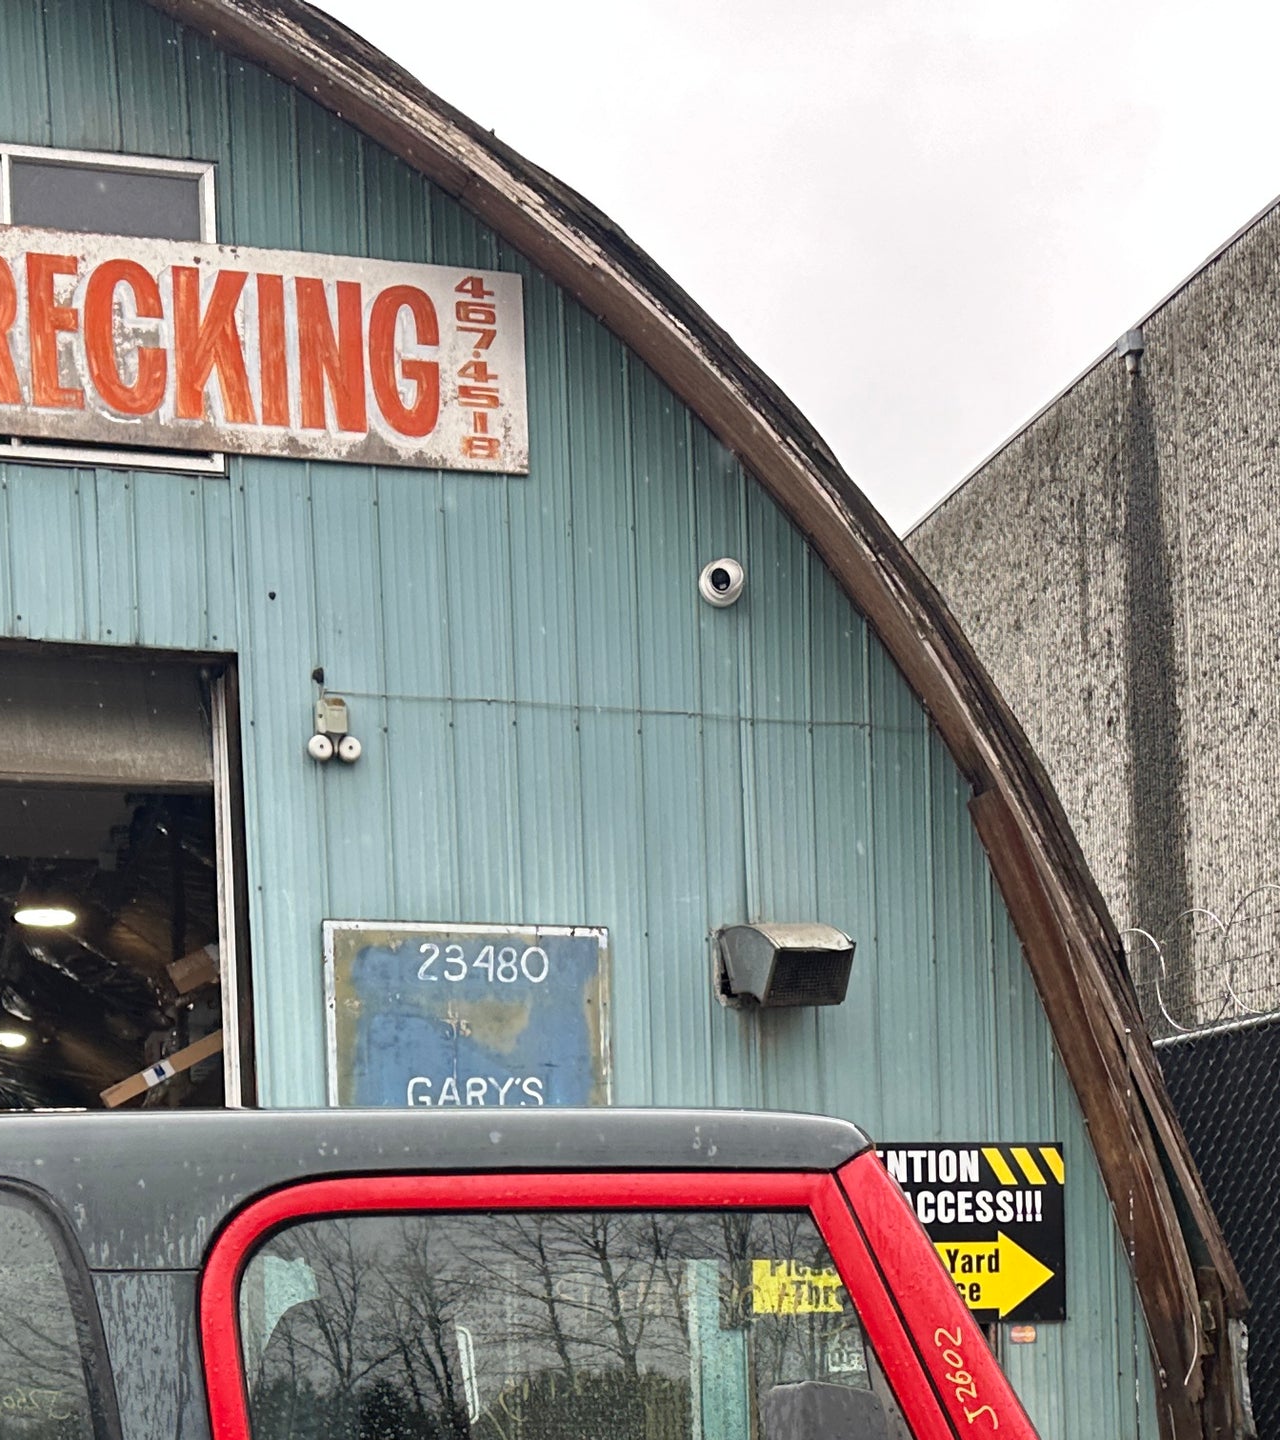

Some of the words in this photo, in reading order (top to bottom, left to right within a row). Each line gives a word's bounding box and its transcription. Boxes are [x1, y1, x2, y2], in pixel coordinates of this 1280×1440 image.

[417, 943, 549, 983] 23480
[407, 1076, 544, 1107] GARY'S
[945, 1248, 1000, 1274] Yard
[934, 1326, 999, 1430] J2602
